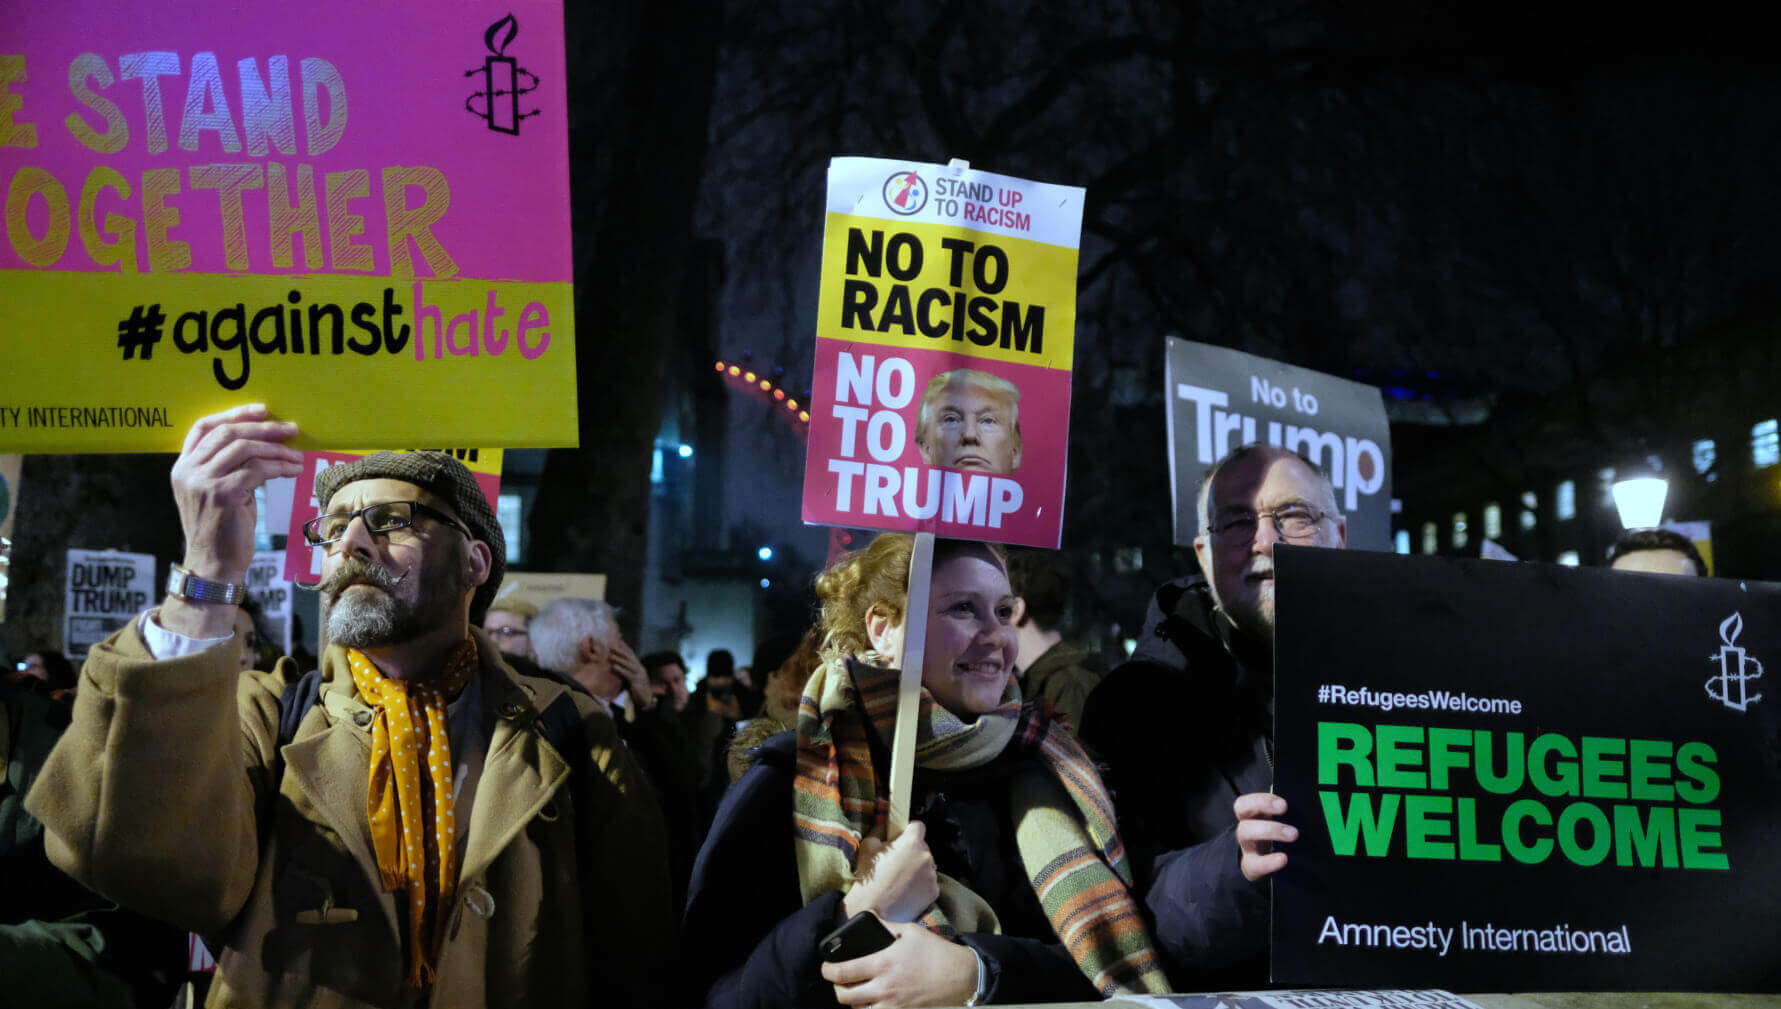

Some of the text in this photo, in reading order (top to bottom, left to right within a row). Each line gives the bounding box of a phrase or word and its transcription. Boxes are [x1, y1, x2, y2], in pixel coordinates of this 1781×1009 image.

[0, 52, 347, 155] E STAND
[5, 161, 460, 279] OGETHER
[934, 198, 1031, 232] TO RACISM
[935, 177, 1023, 209] STAND UP
[845, 228, 1009, 294] NO TO
[117, 281, 551, 390] #againsthate
[841, 279, 1045, 354] RACISM
[834, 352, 916, 409] NO
[1251, 376, 1318, 415] No to
[28, 407, 174, 428] INTERNATIONAL
[832, 405, 906, 463] TO
[828, 460, 1024, 529] TRUMP
[72, 563, 135, 588] DUMP
[72, 589, 146, 614] TRUMP
[1317, 684, 1522, 715] #RefugeesWelcome
[1317, 721, 1721, 804] REFUGEES
[1318, 791, 1730, 870] WELCOME
[1318, 916, 1632, 956] Amnesty International
